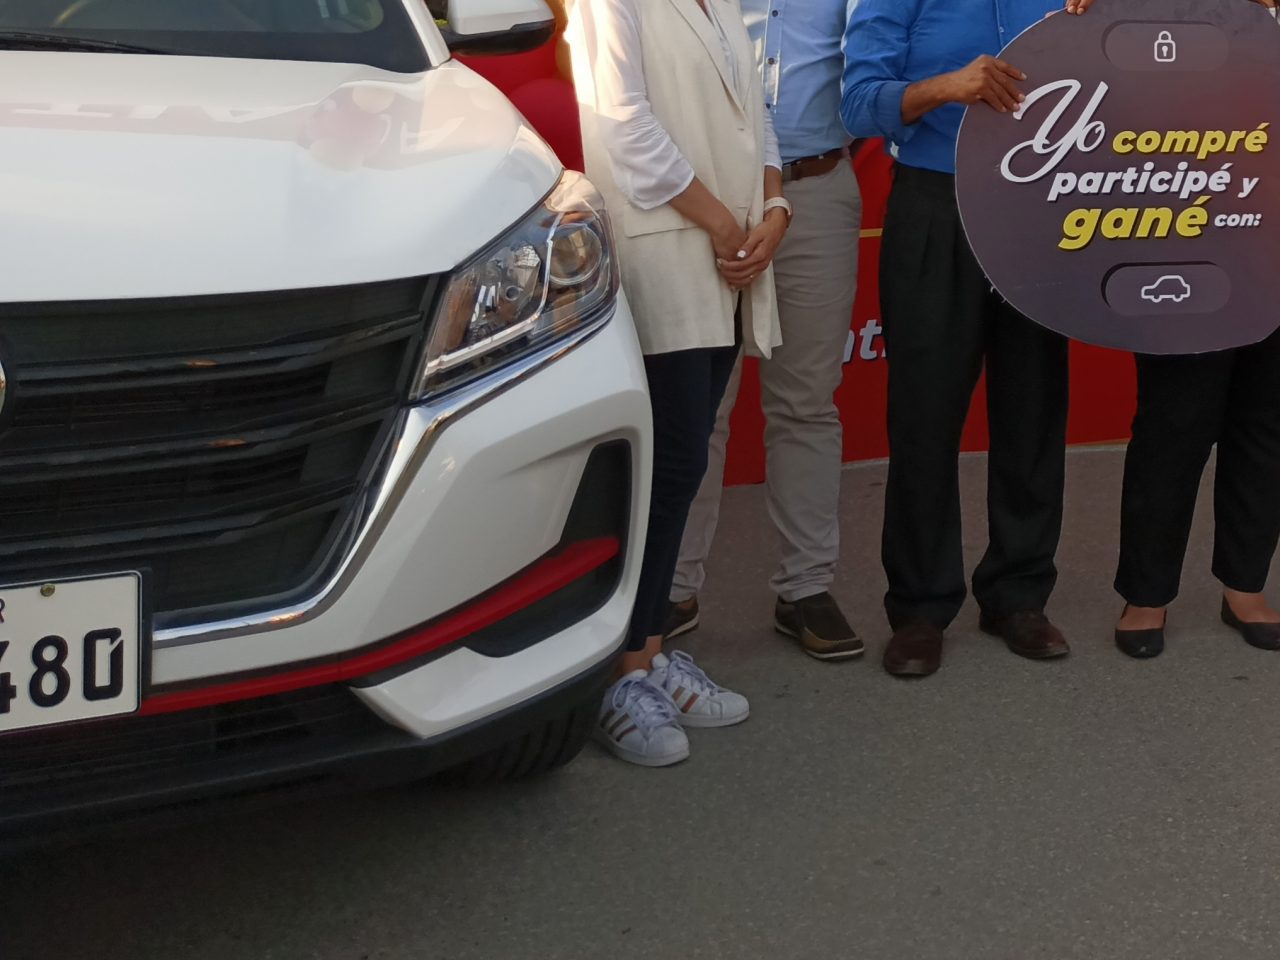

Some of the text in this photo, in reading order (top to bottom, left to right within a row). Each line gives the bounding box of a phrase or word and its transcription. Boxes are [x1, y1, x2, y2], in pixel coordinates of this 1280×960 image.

[999, 78, 1271, 184] Yo compré
[1046, 161, 1261, 202] participé y
[1056, 195, 1263, 252] gané con:
